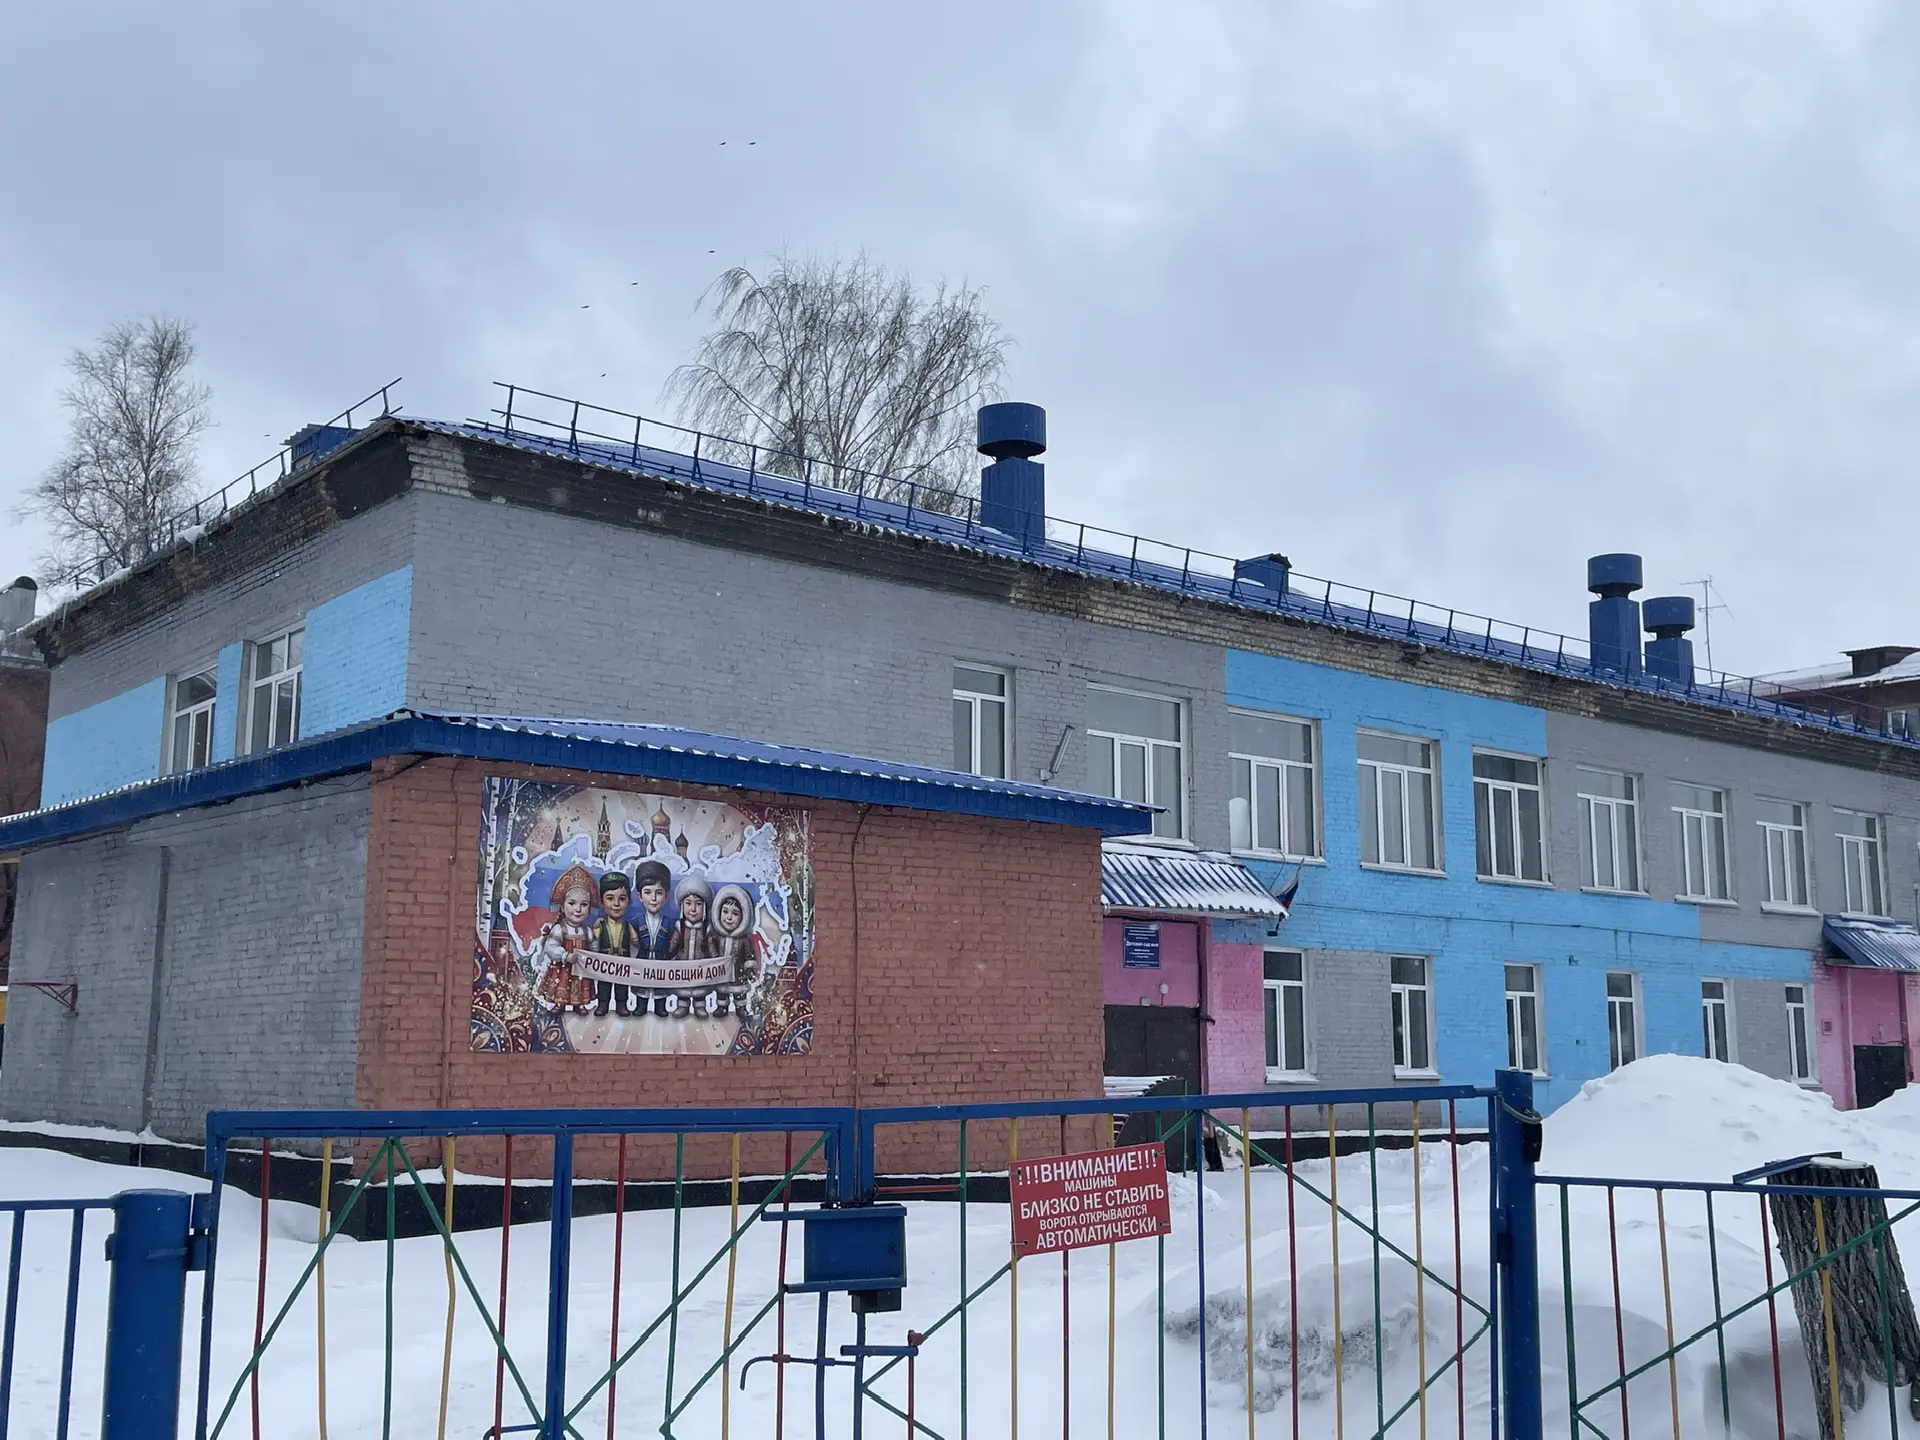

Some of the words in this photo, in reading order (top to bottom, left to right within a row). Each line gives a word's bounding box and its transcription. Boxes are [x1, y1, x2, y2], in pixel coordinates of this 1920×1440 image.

[585, 957, 631, 978] РОССИЯ
[643, 968, 666, 980] НАШ
[668, 966, 704, 982] ОБЩИЙ
[705, 965, 726, 980] ДОМ
[1065, 1175, 1117, 1193] МАШИНЫ
[1021, 1195, 1080, 1220] БЛИЗКО
[1084, 1192, 1103, 1210] НЕ
[1105, 1184, 1165, 1207] СТАВИТЬ
[1040, 1217, 1077, 1230] ВОРОТА
[1079, 1204, 1148, 1224] ОТКРЫВАЮТСЯ
[1036, 1216, 1157, 1250] АВТОМАТИЧЕСКИ
